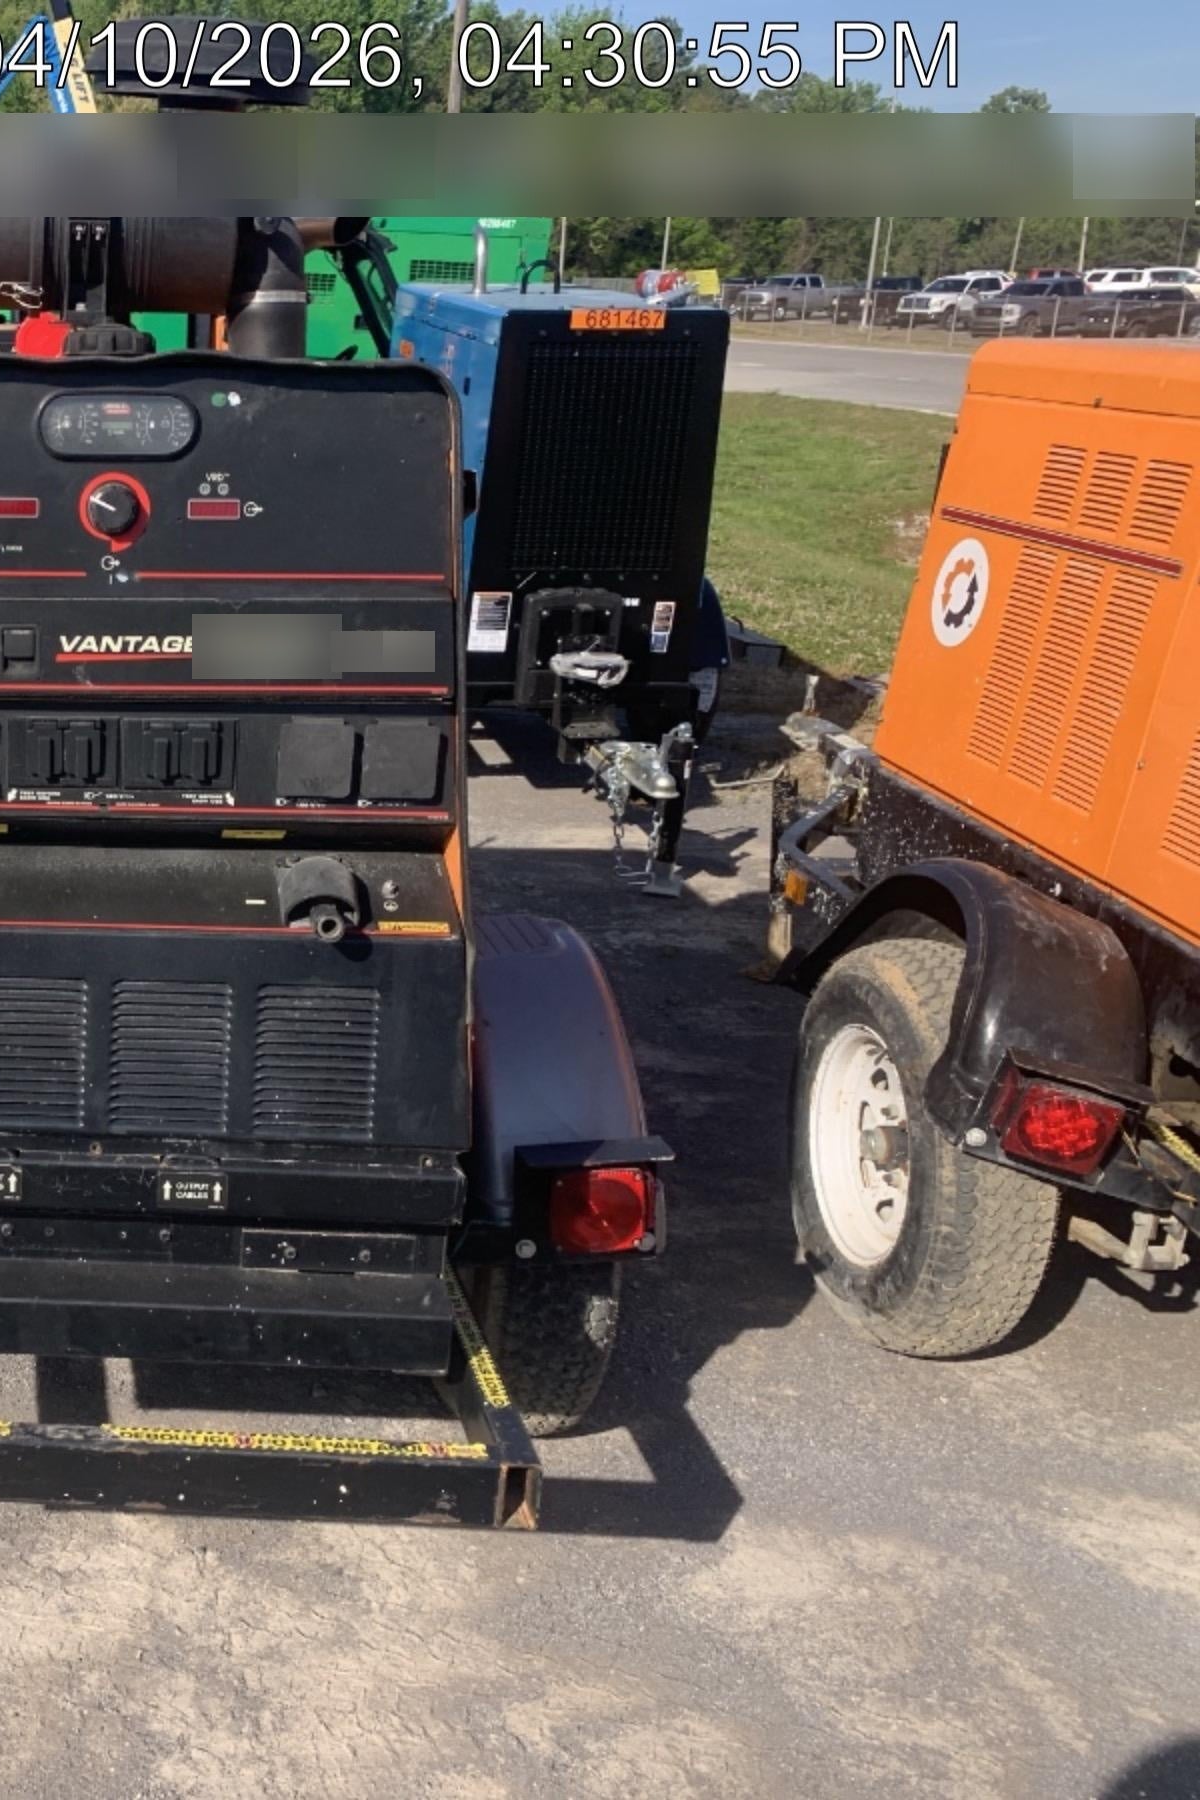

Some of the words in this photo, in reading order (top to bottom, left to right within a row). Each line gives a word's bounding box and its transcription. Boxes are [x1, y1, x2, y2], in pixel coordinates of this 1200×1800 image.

[585, 311, 663, 329] 681467
[175, 1182, 209, 1191] OUTPUT
[175, 1191, 209, 1200] CABLES
